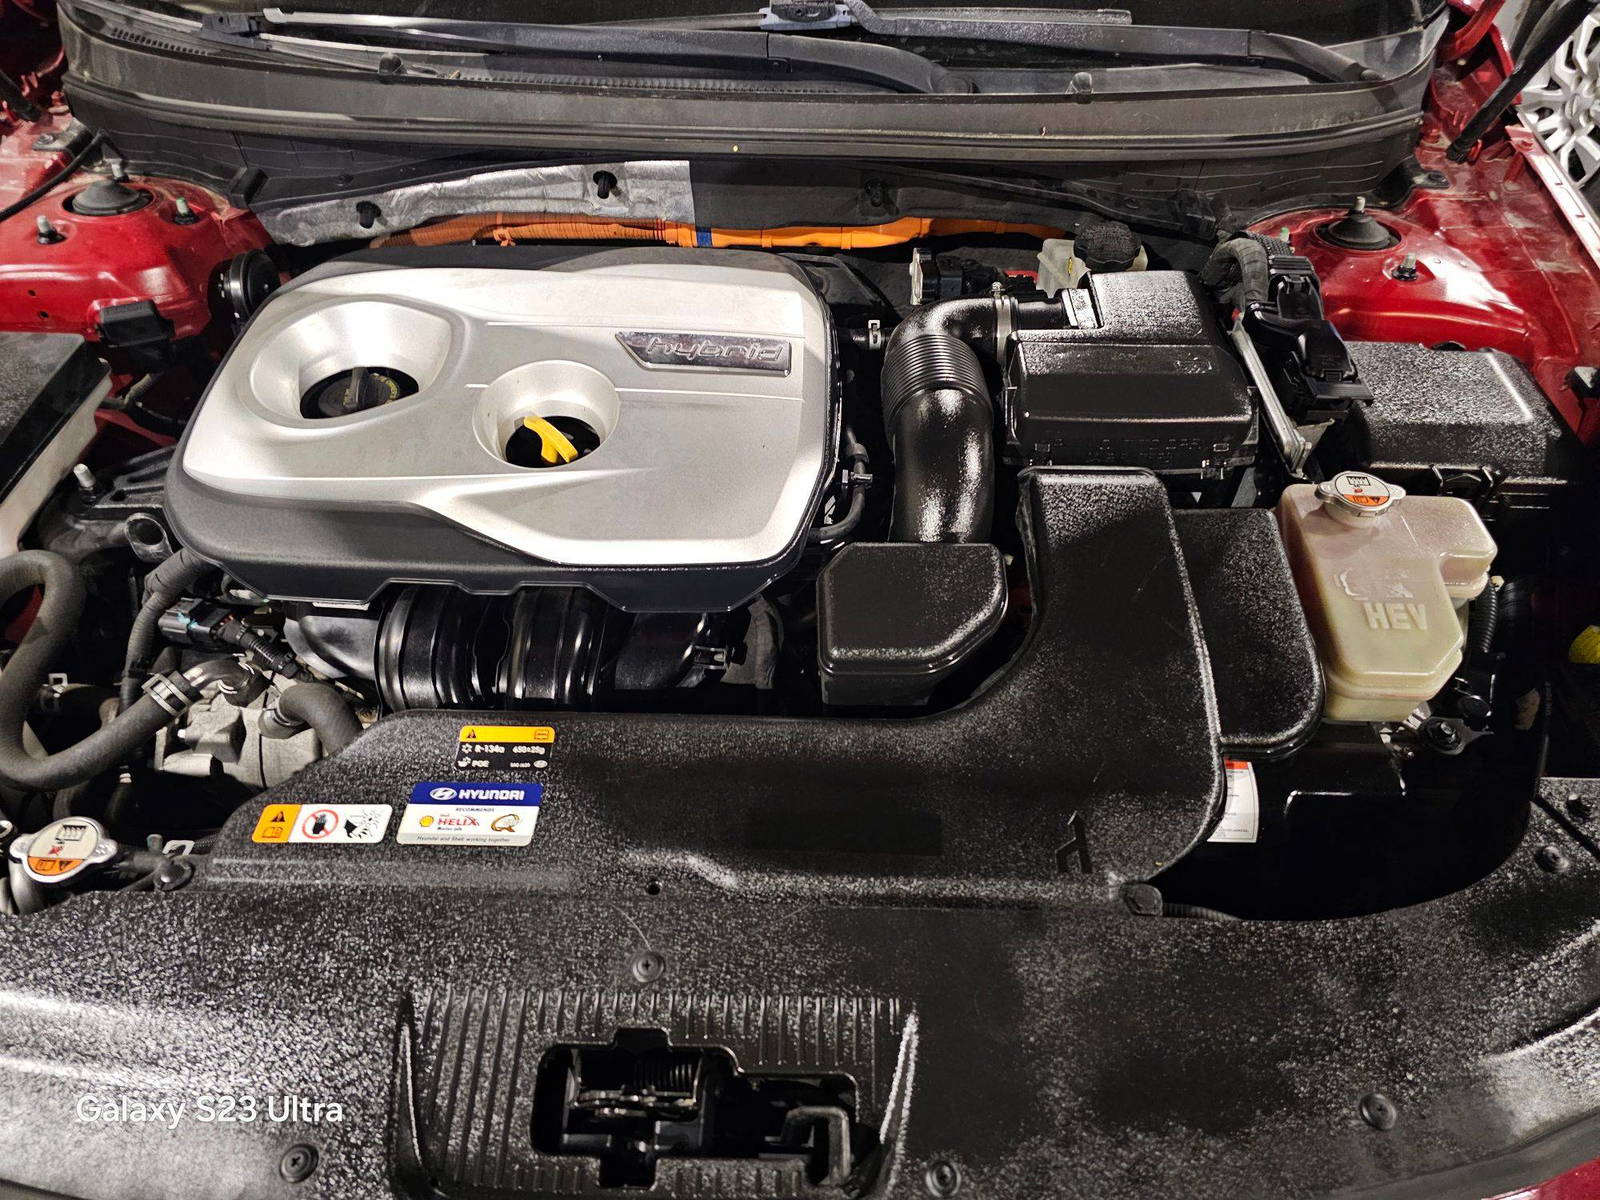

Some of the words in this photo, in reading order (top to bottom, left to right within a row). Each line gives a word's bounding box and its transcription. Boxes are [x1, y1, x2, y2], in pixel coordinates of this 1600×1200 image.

[647, 337, 785, 361] hybrid
[1362, 602, 1428, 630] HEV
[458, 789, 525, 801] HYUNDAI
[437, 815, 480, 827] HELIX
